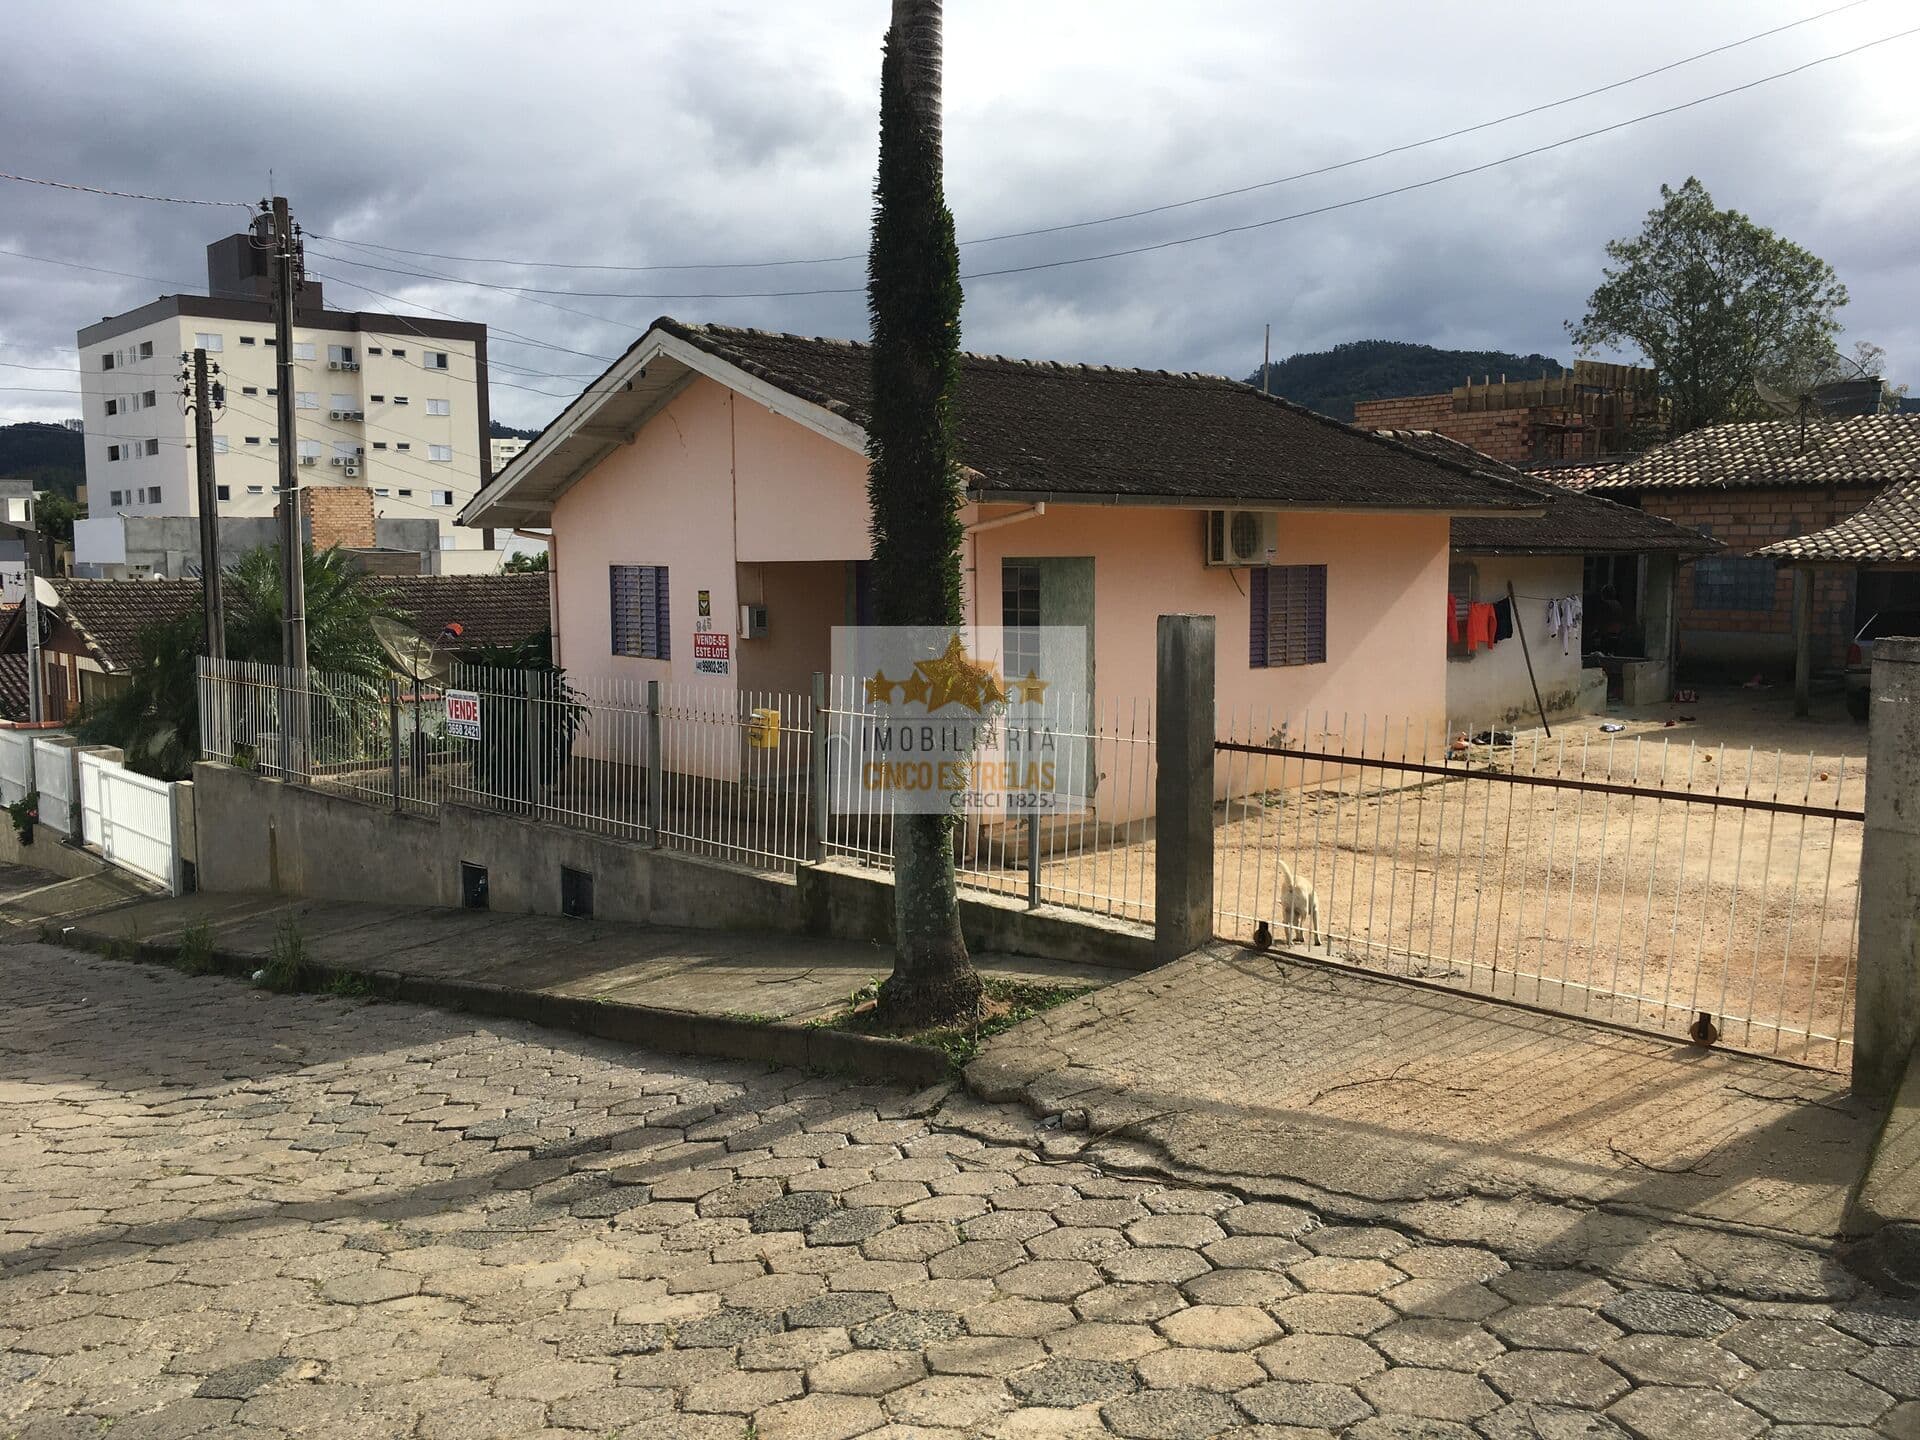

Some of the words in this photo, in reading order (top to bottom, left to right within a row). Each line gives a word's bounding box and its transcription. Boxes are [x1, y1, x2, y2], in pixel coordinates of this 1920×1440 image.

[696, 635, 726, 646] VENDE-SE
[695, 647, 711, 657] ESTE
[712, 648, 728, 658] LOTE
[448, 699, 478, 721] VENDE
